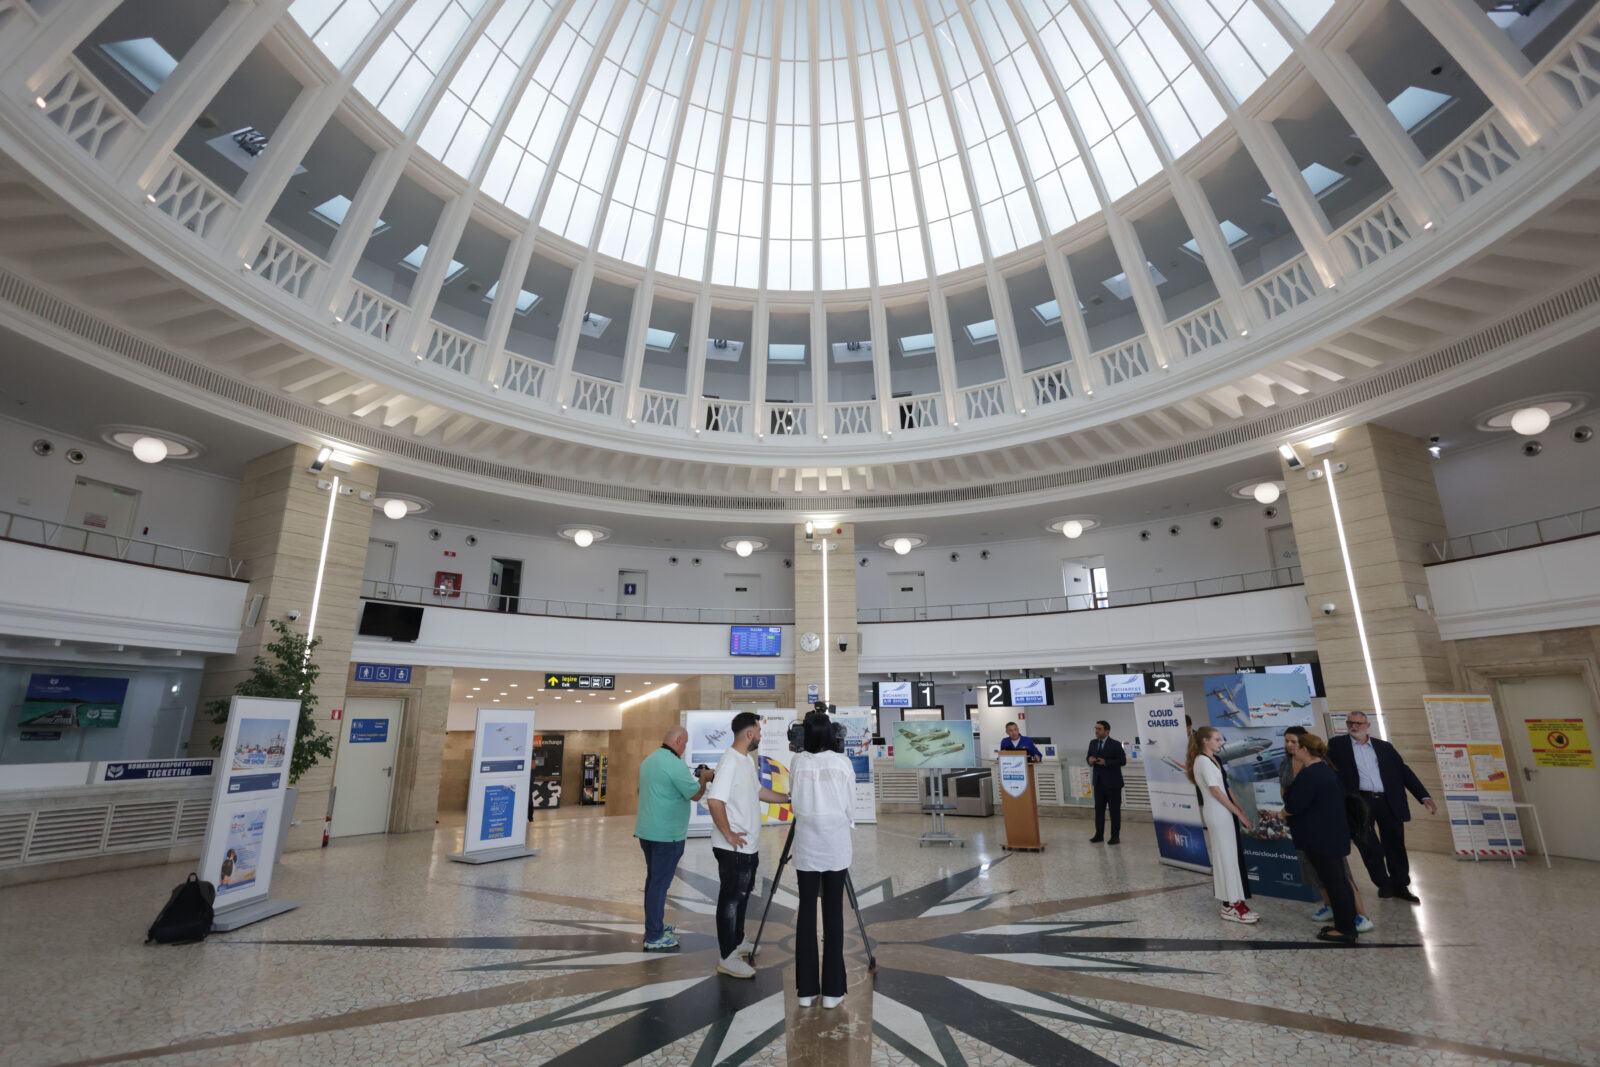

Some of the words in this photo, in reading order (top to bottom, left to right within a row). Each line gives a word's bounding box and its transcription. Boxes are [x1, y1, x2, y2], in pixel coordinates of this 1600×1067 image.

[604, 678, 611, 687] P
[922, 687, 931, 707] 1
[989, 685, 1004, 705] 2
[1149, 709, 1173, 718] CLOUD
[1147, 719, 1179, 728] CHASERS
[127, 762, 160, 770] ROMANIAN
[159, 761, 185, 769] AIRPORT
[185, 760, 212, 768] SERVICES
[147, 768, 192, 778] TICKETING
[1174, 833, 1189, 848] NFT
